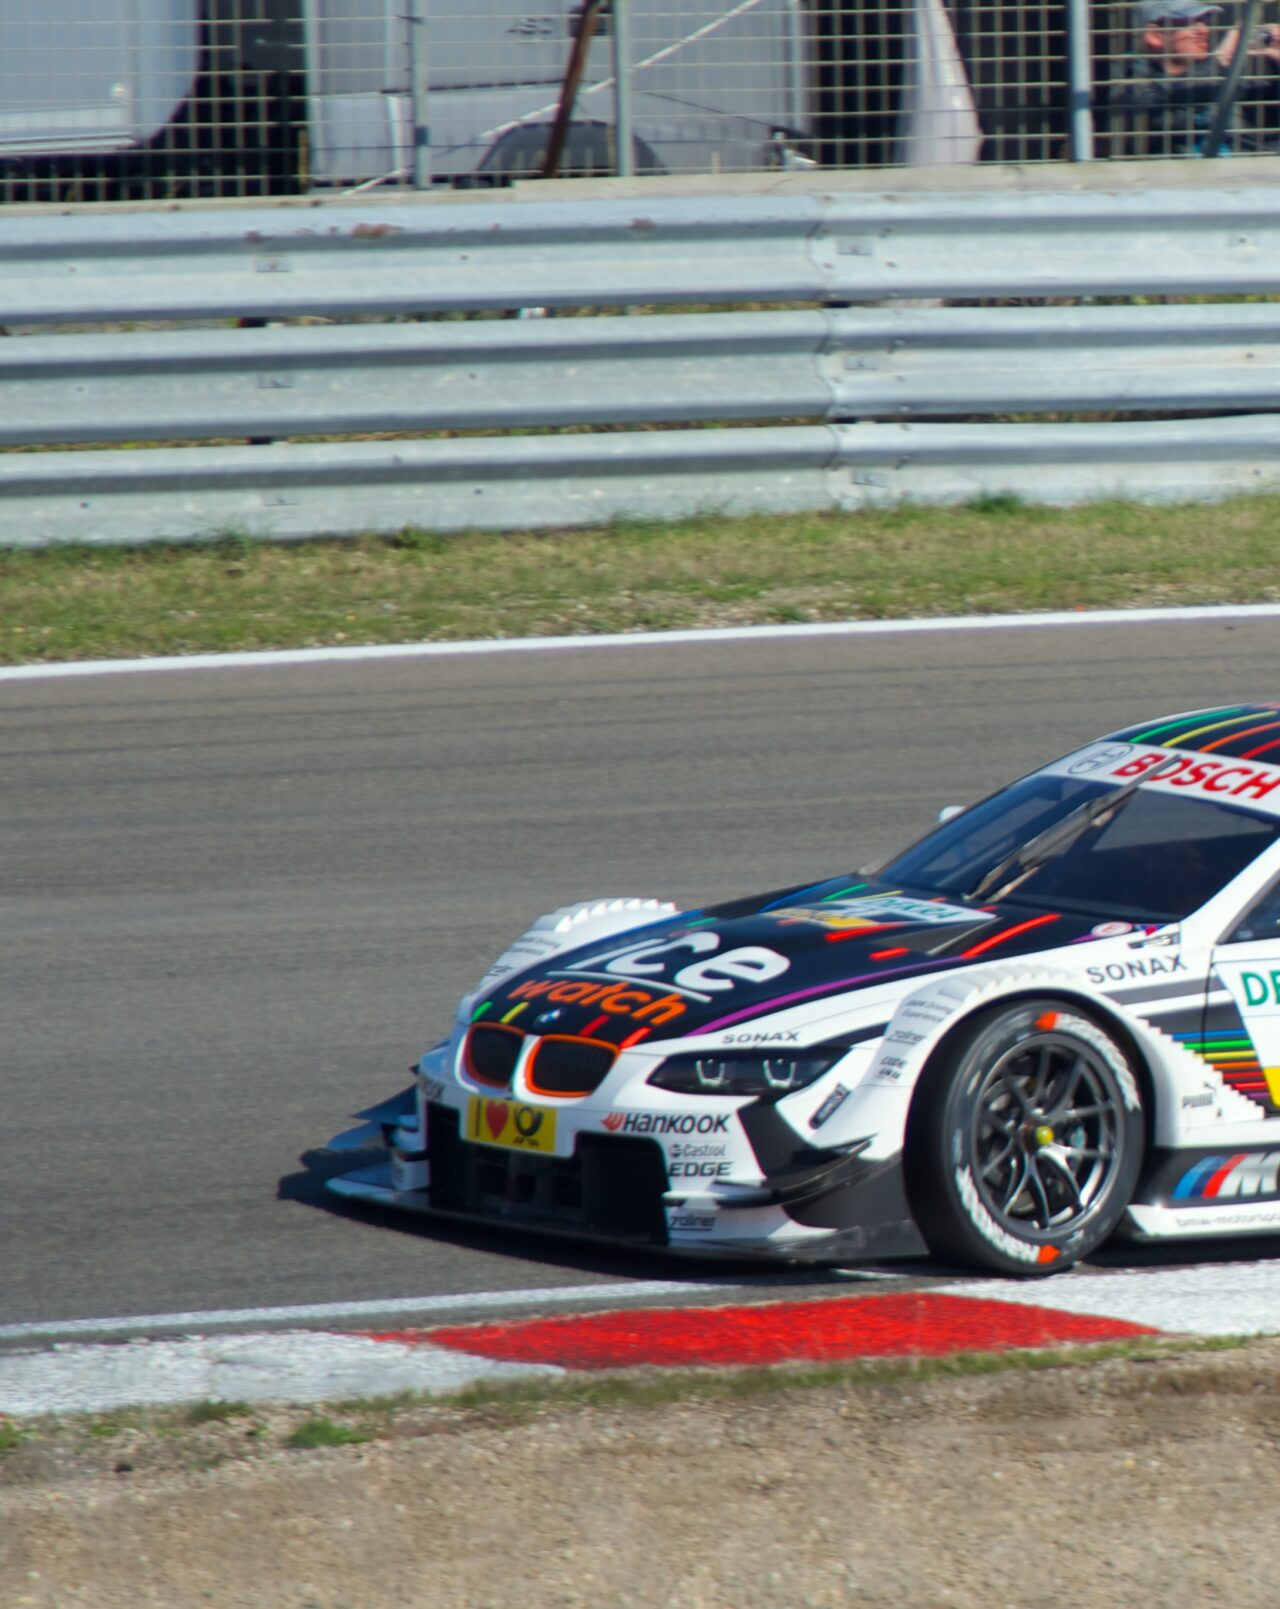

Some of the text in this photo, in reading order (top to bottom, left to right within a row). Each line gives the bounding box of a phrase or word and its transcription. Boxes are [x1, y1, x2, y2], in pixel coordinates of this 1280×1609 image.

[564, 931, 791, 991] ice
[1086, 954, 1188, 984] SONAX
[507, 979, 688, 1026] watch
[721, 1031, 800, 1045] SONAX
[682, 1143, 727, 1157] Castrol
[668, 1161, 734, 1178] EDGE
